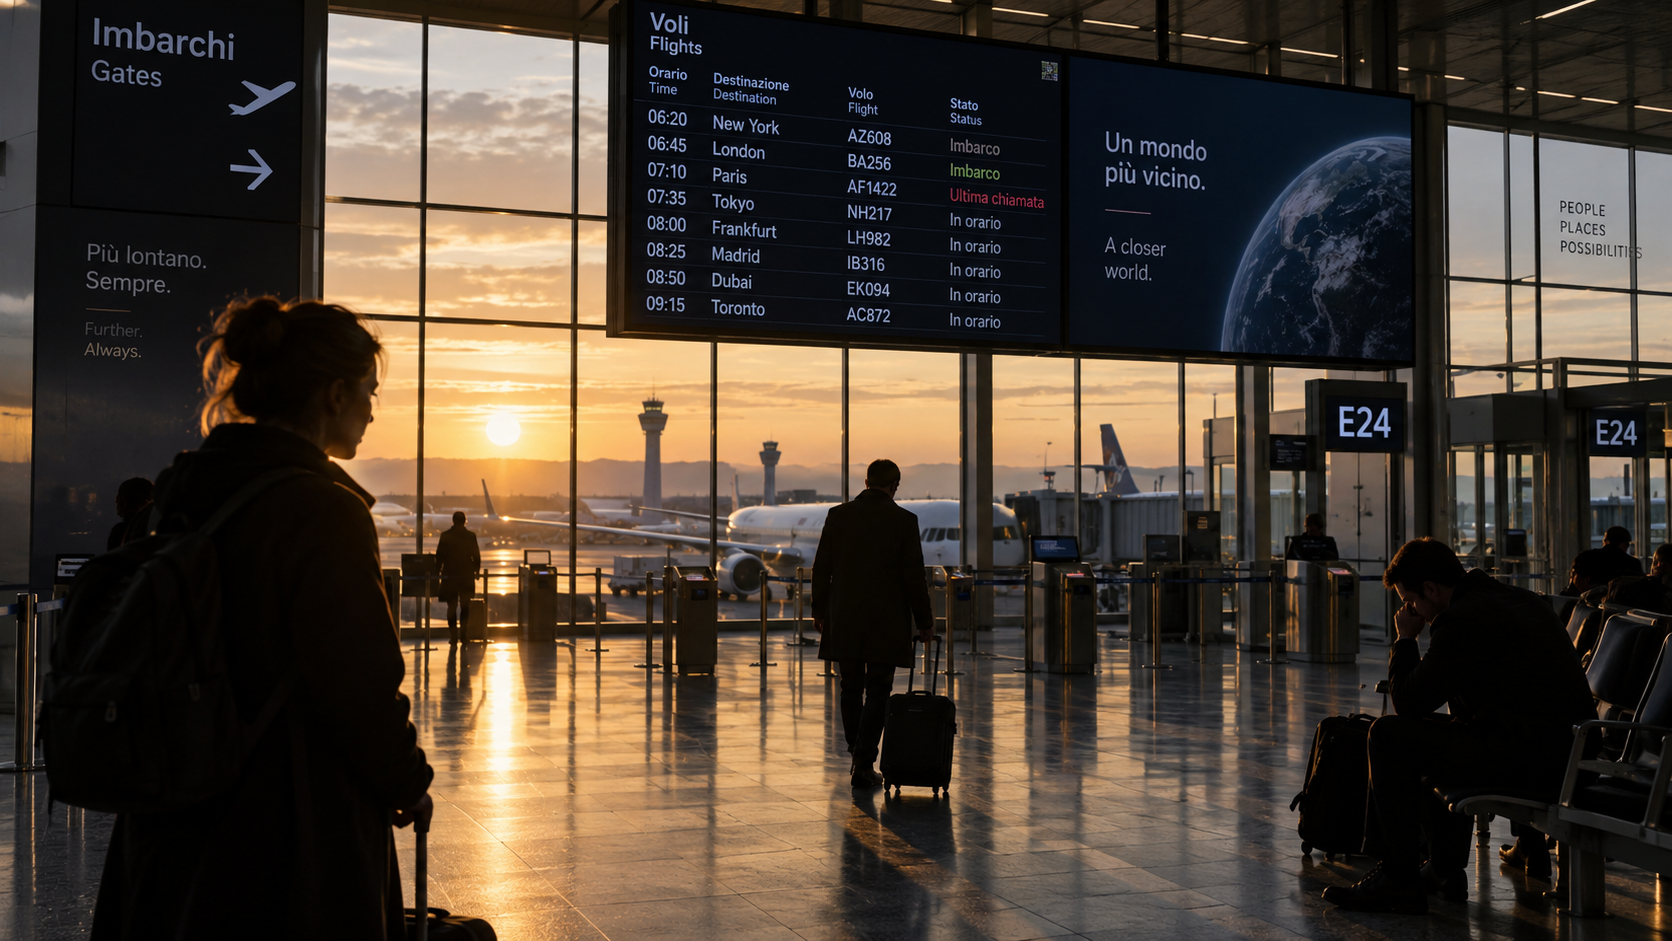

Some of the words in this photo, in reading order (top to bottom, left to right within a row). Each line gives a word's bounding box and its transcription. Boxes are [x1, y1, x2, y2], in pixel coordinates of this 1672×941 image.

[650, 12, 688, 34] Voli
[94, 18, 234, 61] Imbarchi
[651, 36, 702, 55] Flights
[92, 60, 161, 87] Gates
[649, 66, 687, 80] Orario
[714, 73, 789, 92] Destinazione
[848, 87, 873, 99] Volo
[951, 98, 978, 111] Stato
[649, 82, 677, 95] Time
[714, 87, 777, 105] Destination
[849, 102, 878, 116] Flight
[951, 113, 982, 125] Status
[649, 109, 687, 126] 06:20
[714, 115, 744, 131] New
[749, 118, 779, 135] York
[848, 129, 891, 145] AZ608
[951, 138, 1000, 155] Imbarco
[1106, 131, 1132, 153] Un
[1141, 140, 1206, 161] mondo
[648, 136, 686, 152] 06:45
[713, 141, 765, 159] London
[849, 154, 891, 170] BA256
[951, 163, 1000, 180] Imbarco
[648, 162, 686, 179] 07:10
[713, 167, 747, 184] Paris
[848, 179, 896, 196] AF1422
[951, 188, 988, 203] Ultima
[992, 193, 1044, 208] chiamata
[1106, 162, 1135, 187] più
[1143, 166, 1205, 190] vicino.
[648, 189, 686, 205] 07:35
[712, 194, 754, 213] Tokyo
[848, 205, 892, 221] NH217
[951, 213, 961, 226] In
[966, 216, 1001, 229] orario
[1560, 201, 1606, 216] PEOPLE
[648, 216, 686, 232] 08:00
[713, 220, 777, 238] Frankfurt
[848, 230, 890, 246] LH982
[951, 237, 961, 251] In
[965, 241, 1001, 254] orario
[1561, 221, 1606, 236] PLACES
[88, 244, 118, 263] Più
[127, 245, 206, 268] lontano.
[647, 242, 685, 258] 08:25
[712, 246, 759, 263] Madrid
[848, 256, 884, 271] IB316
[950, 262, 961, 276] In
[965, 265, 1001, 278] orario
[1105, 237, 1116, 253] A
[1121, 238, 1166, 256] closer
[1561, 240, 1642, 259] POSSIBILITIES
[86, 271, 170, 296] Sempre.
[647, 269, 685, 285] 08:50
[712, 273, 751, 289] Dubai
[848, 281, 890, 297] EK094
[950, 287, 961, 301] In
[965, 290, 1000, 303] orario
[1105, 264, 1151, 281] world.
[647, 296, 685, 312] 09:15
[711, 299, 765, 316] Toronto
[847, 307, 890, 322] AC872
[950, 313, 960, 326] In
[965, 315, 1000, 328] orario
[85, 322, 142, 337] Further.
[84, 343, 141, 360] Always.
[1339, 406, 1391, 438] E24
[1597, 420, 1637, 445] E24
